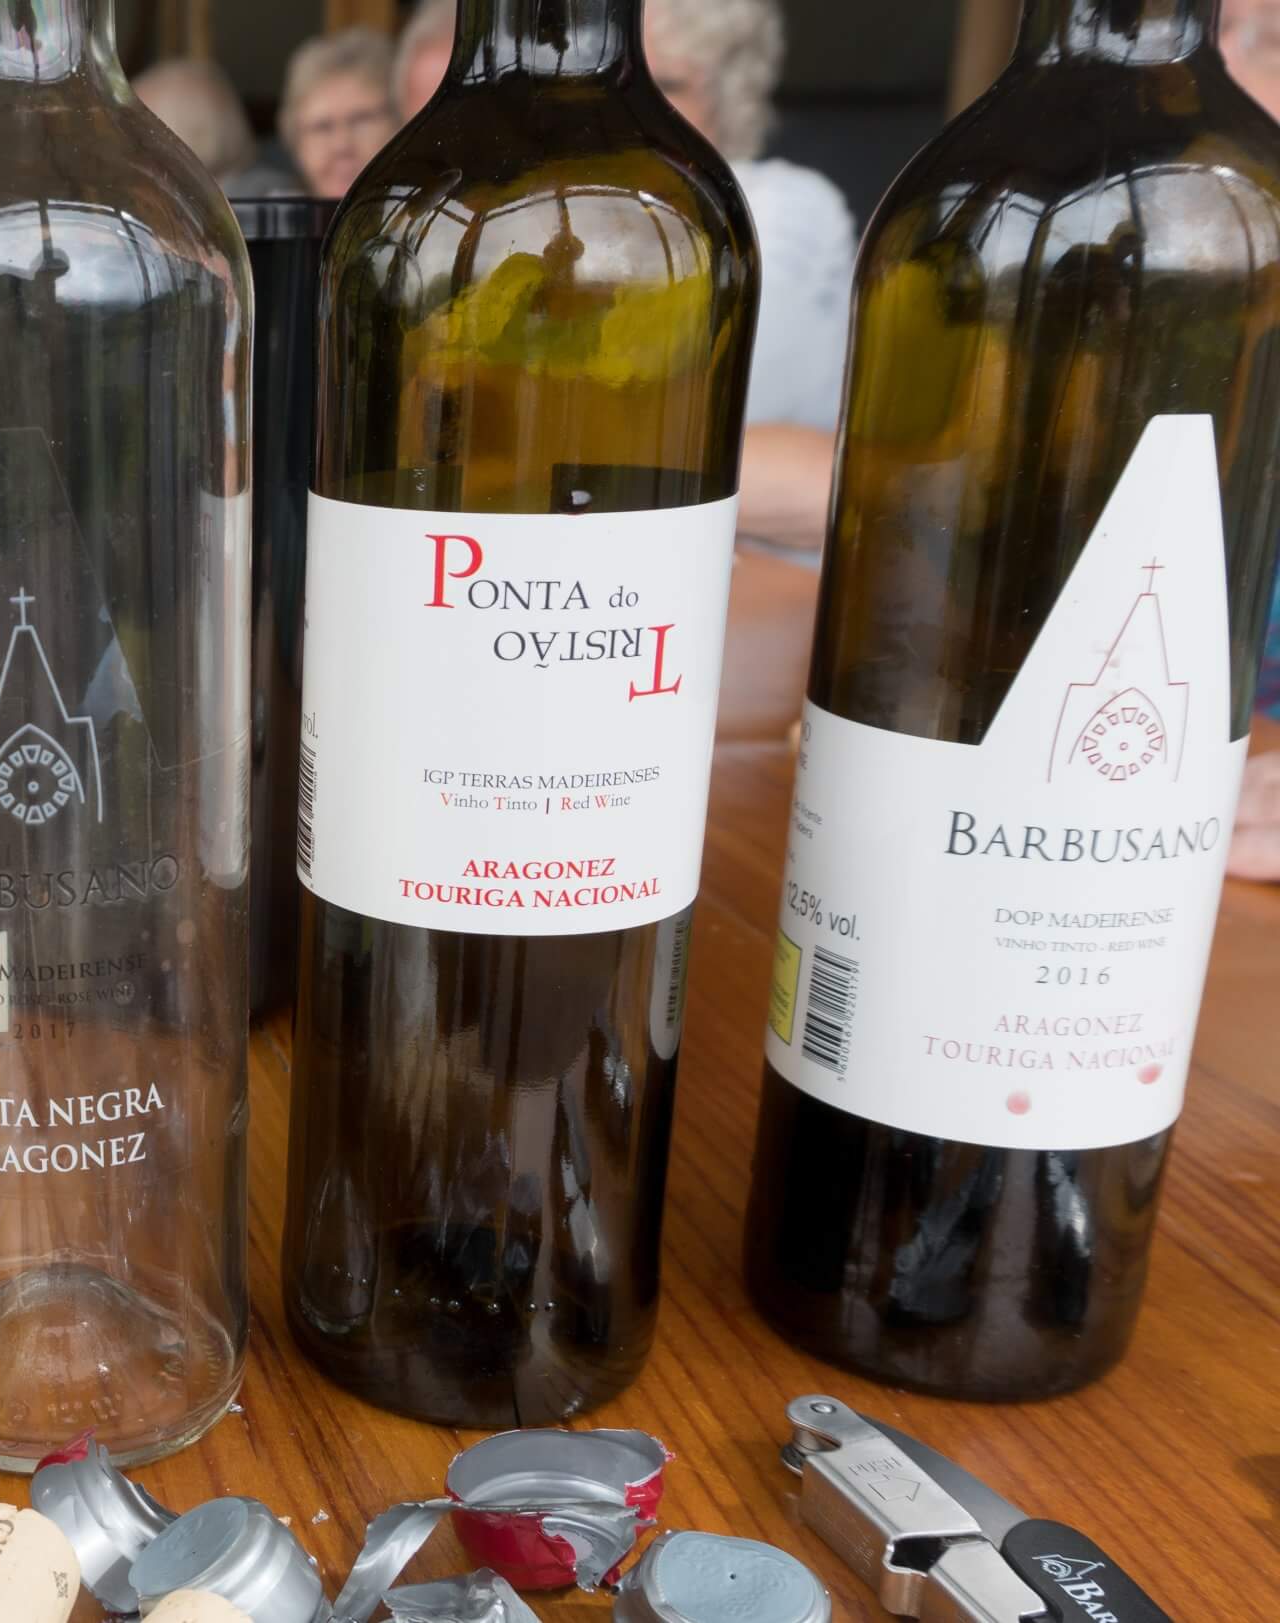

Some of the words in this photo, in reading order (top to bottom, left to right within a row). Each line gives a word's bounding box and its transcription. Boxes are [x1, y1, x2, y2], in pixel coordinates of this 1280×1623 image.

[424, 534, 590, 611] PONTA
[608, 585, 639, 610] do
[423, 768, 454, 785] IGP
[458, 772, 533, 790] TERRAS
[537, 766, 661, 790] MADEIRENSES
[441, 792, 489, 809] Vinho
[493, 796, 538, 811] Tinto
[560, 794, 590, 811] Red
[594, 794, 631, 809] Wine
[944, 809, 1220, 863] BARBUSANO
[462, 858, 616, 880] ARAGONEZ
[399, 879, 526, 907] TOURIGA
[532, 877, 662, 908] NACIONAL
[829, 911, 860, 941] vol.
[994, 908, 1043, 926] DOP
[1047, 907, 1175, 929] MADEIRENSE
[994, 936, 1047, 952] VINHO
[1051, 940, 1098, 953] TINTO
[1035, 965, 1111, 985] 2016
[13, 1021, 76, 1040] 2017
[993, 1013, 1145, 1037] ARAGONEZ
[922, 1035, 1055, 1070] TOURIGA
[48, 1081, 166, 1127] NEGRA
[847, 1456, 903, 1476] PUSH
